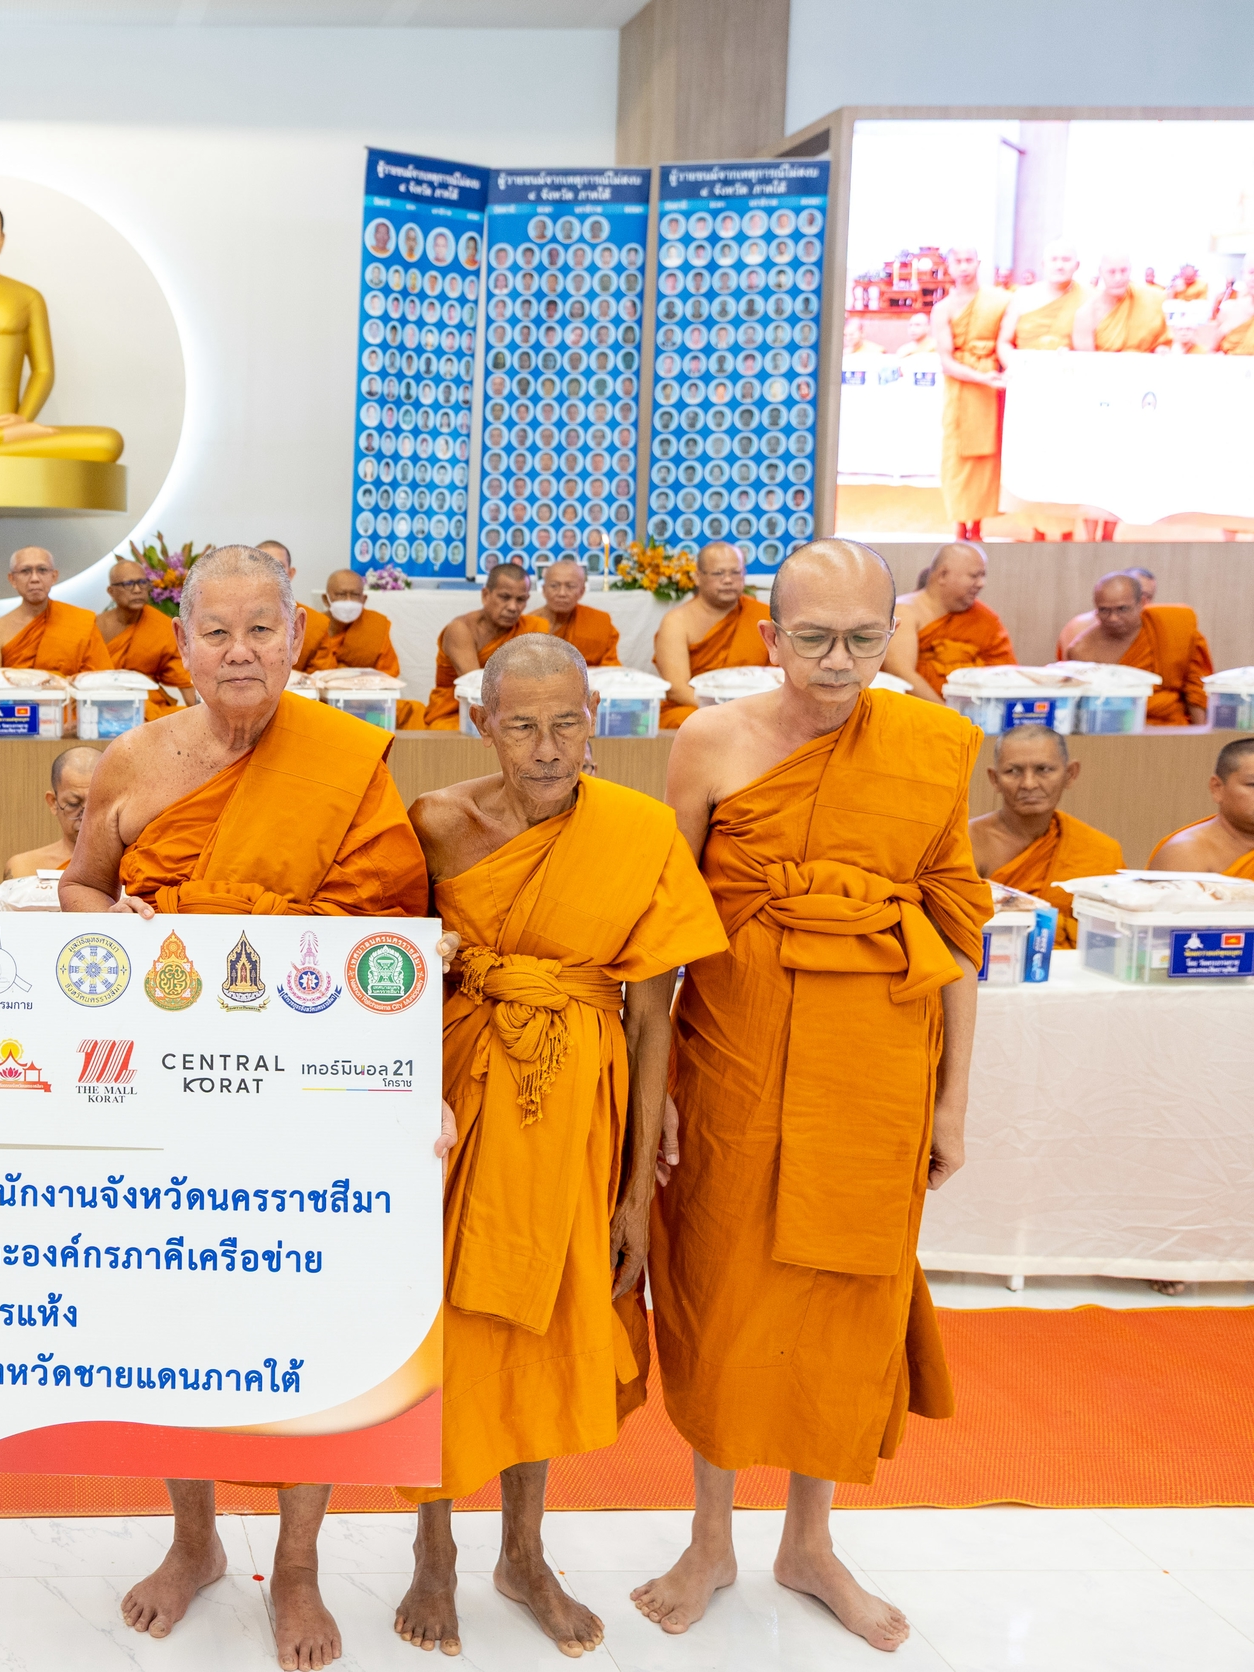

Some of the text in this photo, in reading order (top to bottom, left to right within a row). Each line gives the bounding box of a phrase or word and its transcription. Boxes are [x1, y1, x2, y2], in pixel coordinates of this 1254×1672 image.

[162, 1053, 285, 1071] CENTRAL
[302, 1060, 413, 1076] เทอร์มินอล 21
[183, 1077, 264, 1093] KORAT
[382, 1077, 412, 1088] โคราช
[75, 1086, 137, 1095] THE MALL
[88, 1095, 126, 1103] KORAT
